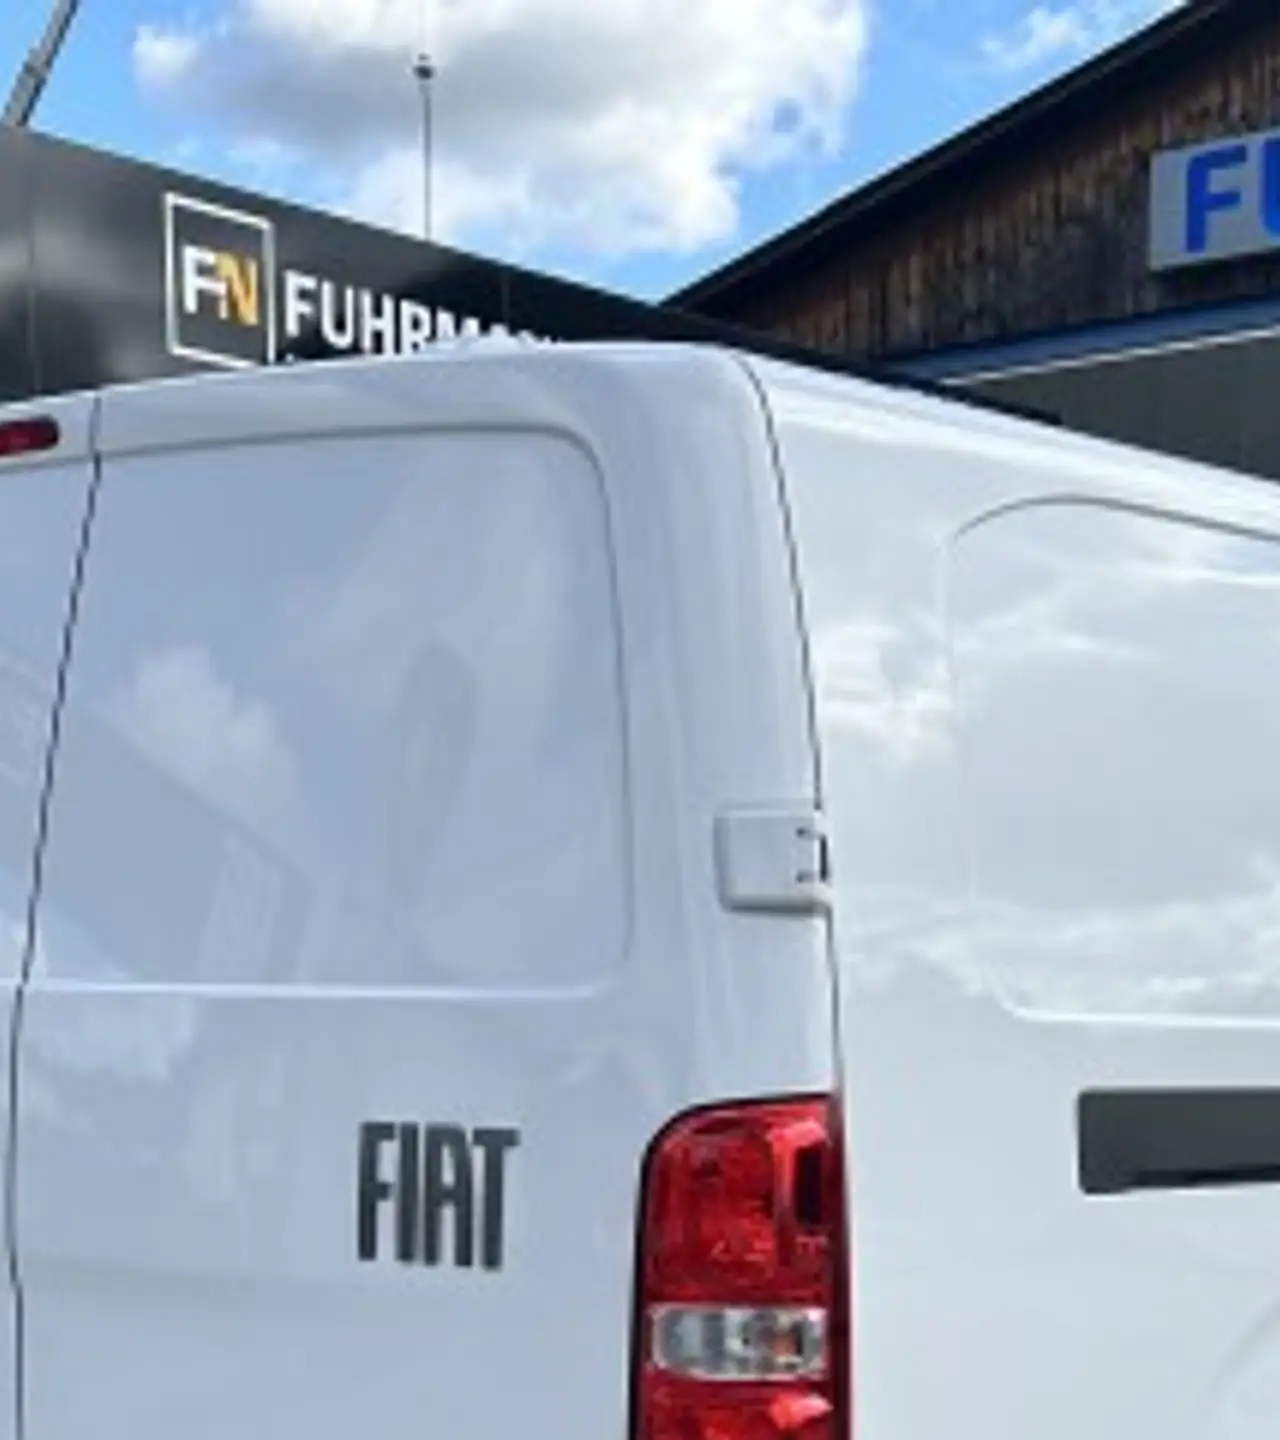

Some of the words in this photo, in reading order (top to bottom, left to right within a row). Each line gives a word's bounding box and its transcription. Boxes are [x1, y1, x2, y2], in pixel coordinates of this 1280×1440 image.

[182, 244, 259, 327] FN
[283, 268, 558, 357] FUHRM
[357, 1121, 521, 1272] FIAT
